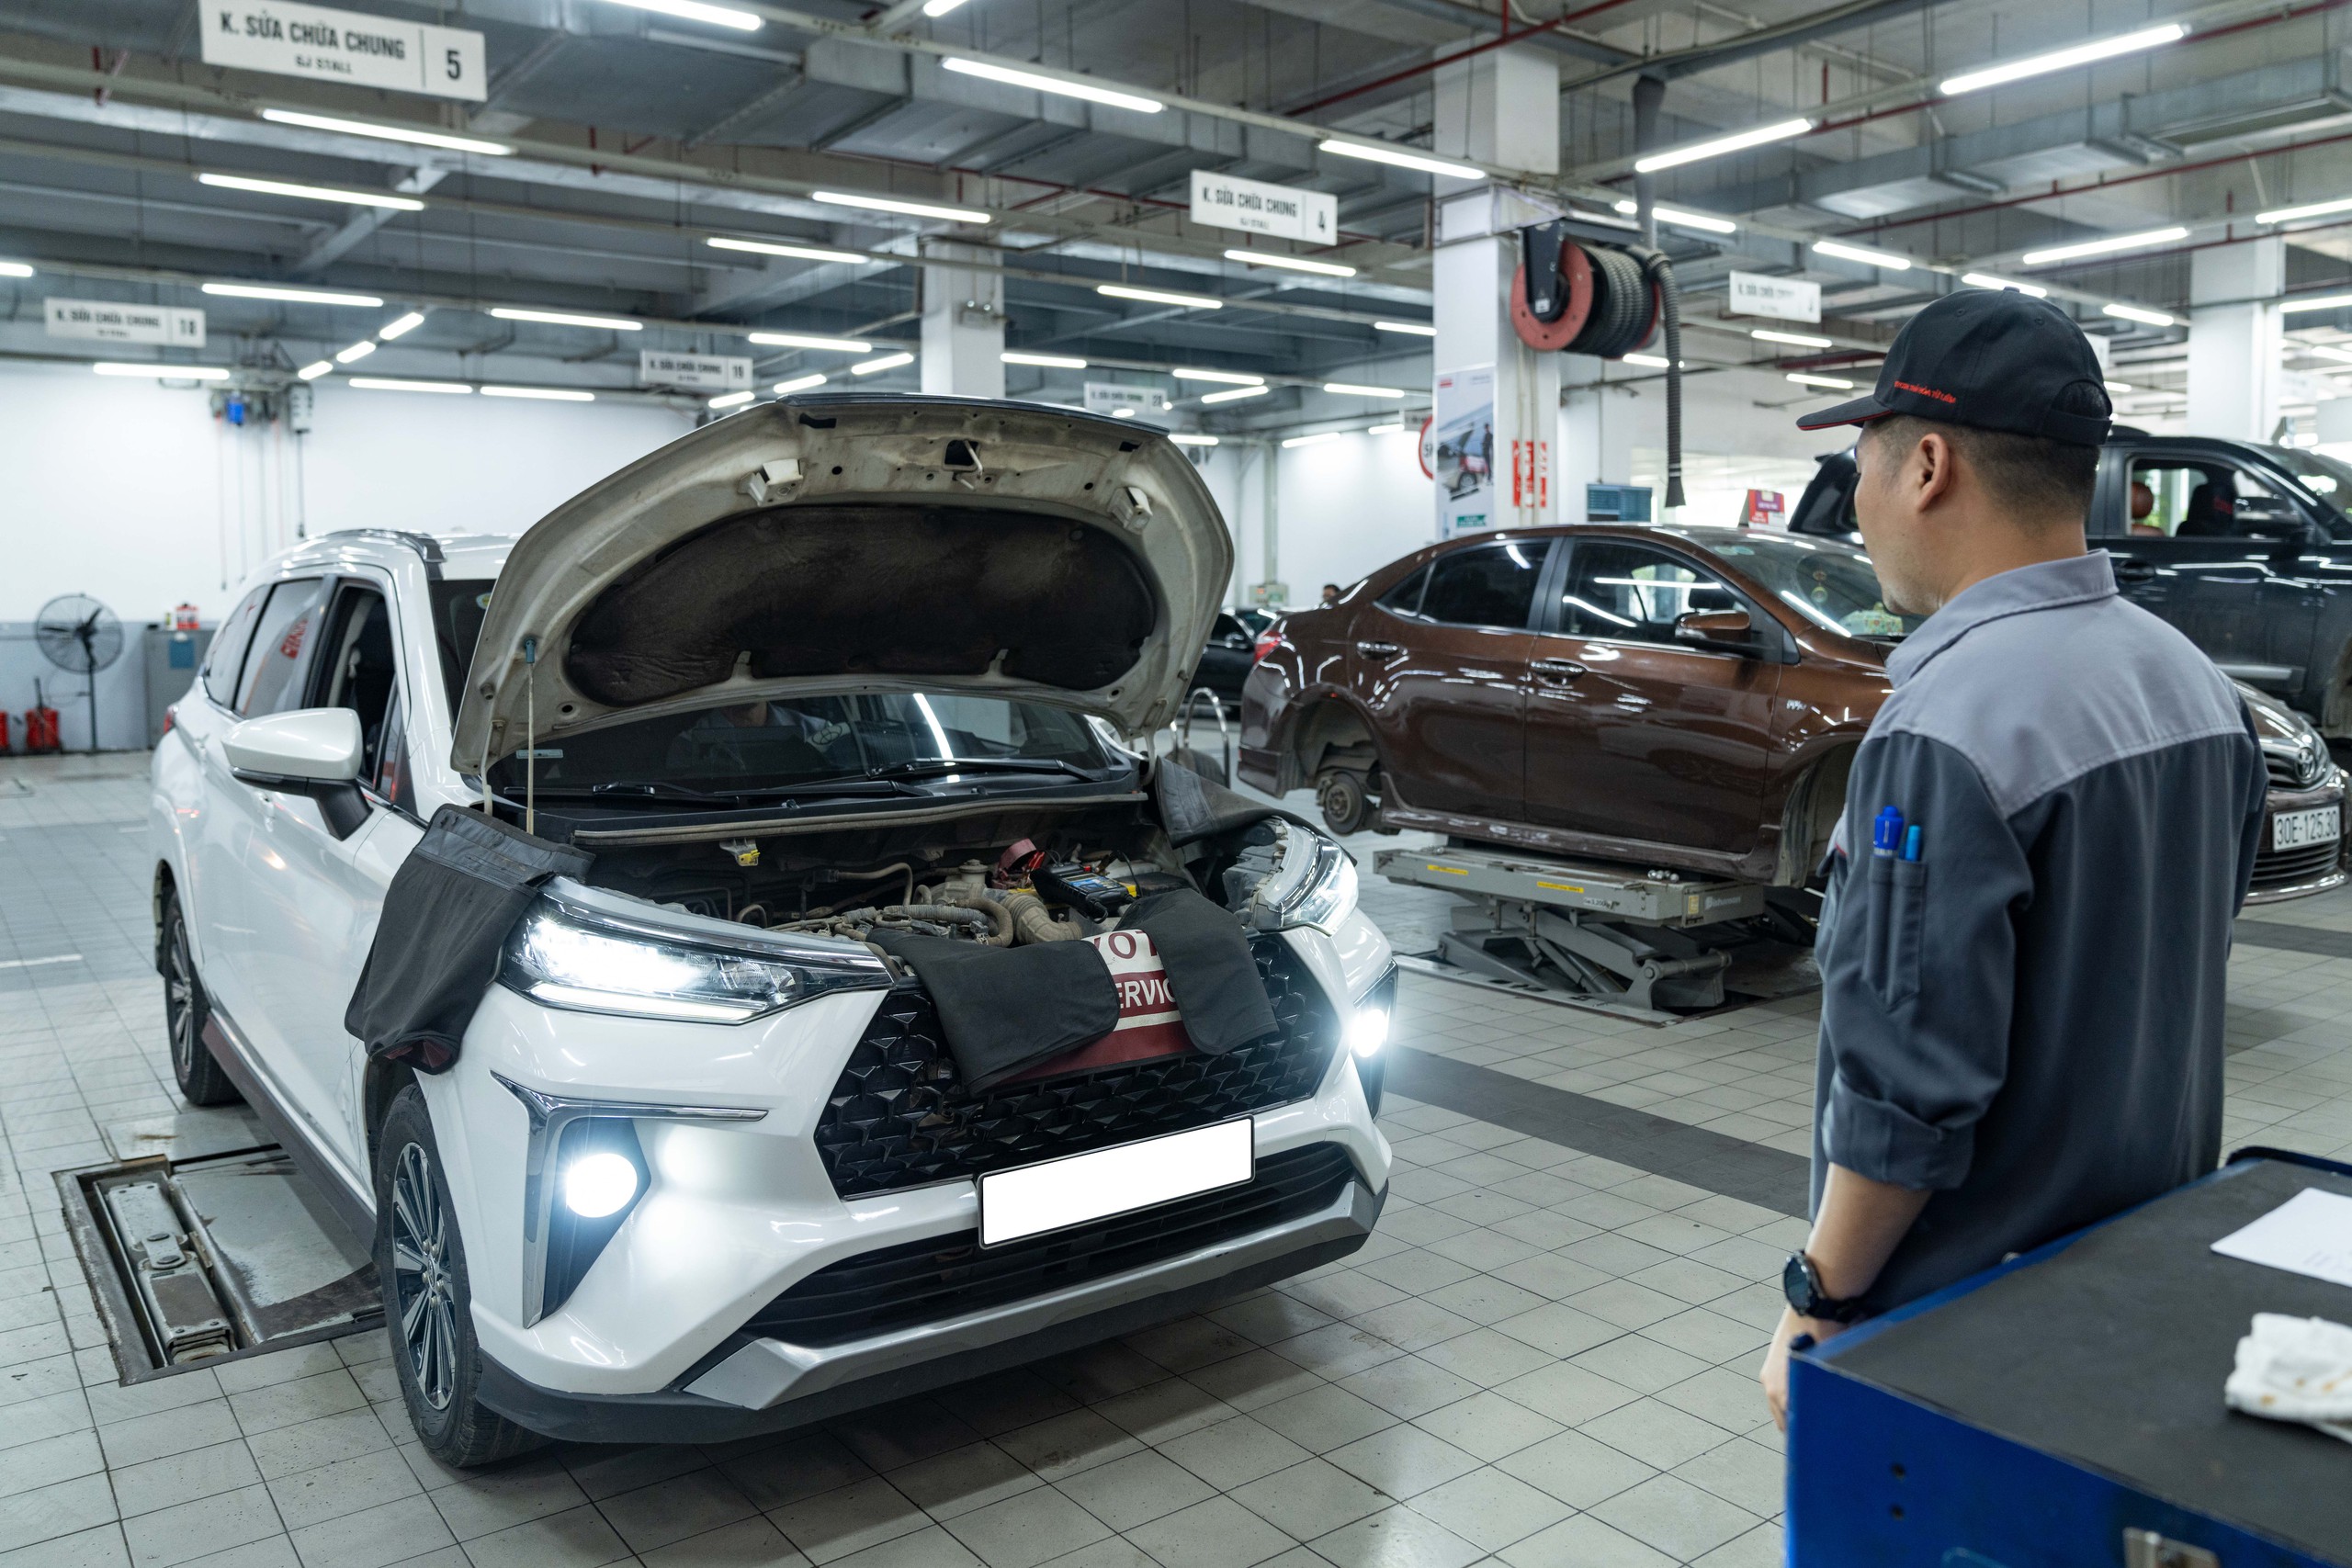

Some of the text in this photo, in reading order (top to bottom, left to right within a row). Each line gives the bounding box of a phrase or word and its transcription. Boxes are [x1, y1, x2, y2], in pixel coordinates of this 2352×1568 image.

[220, 9, 405, 60] K. SỬA CHỮA CHUNG
[447, 50, 461, 80] 5
[1203, 186, 1213, 204] K.
[1266, 198, 1297, 218] CHUNG
